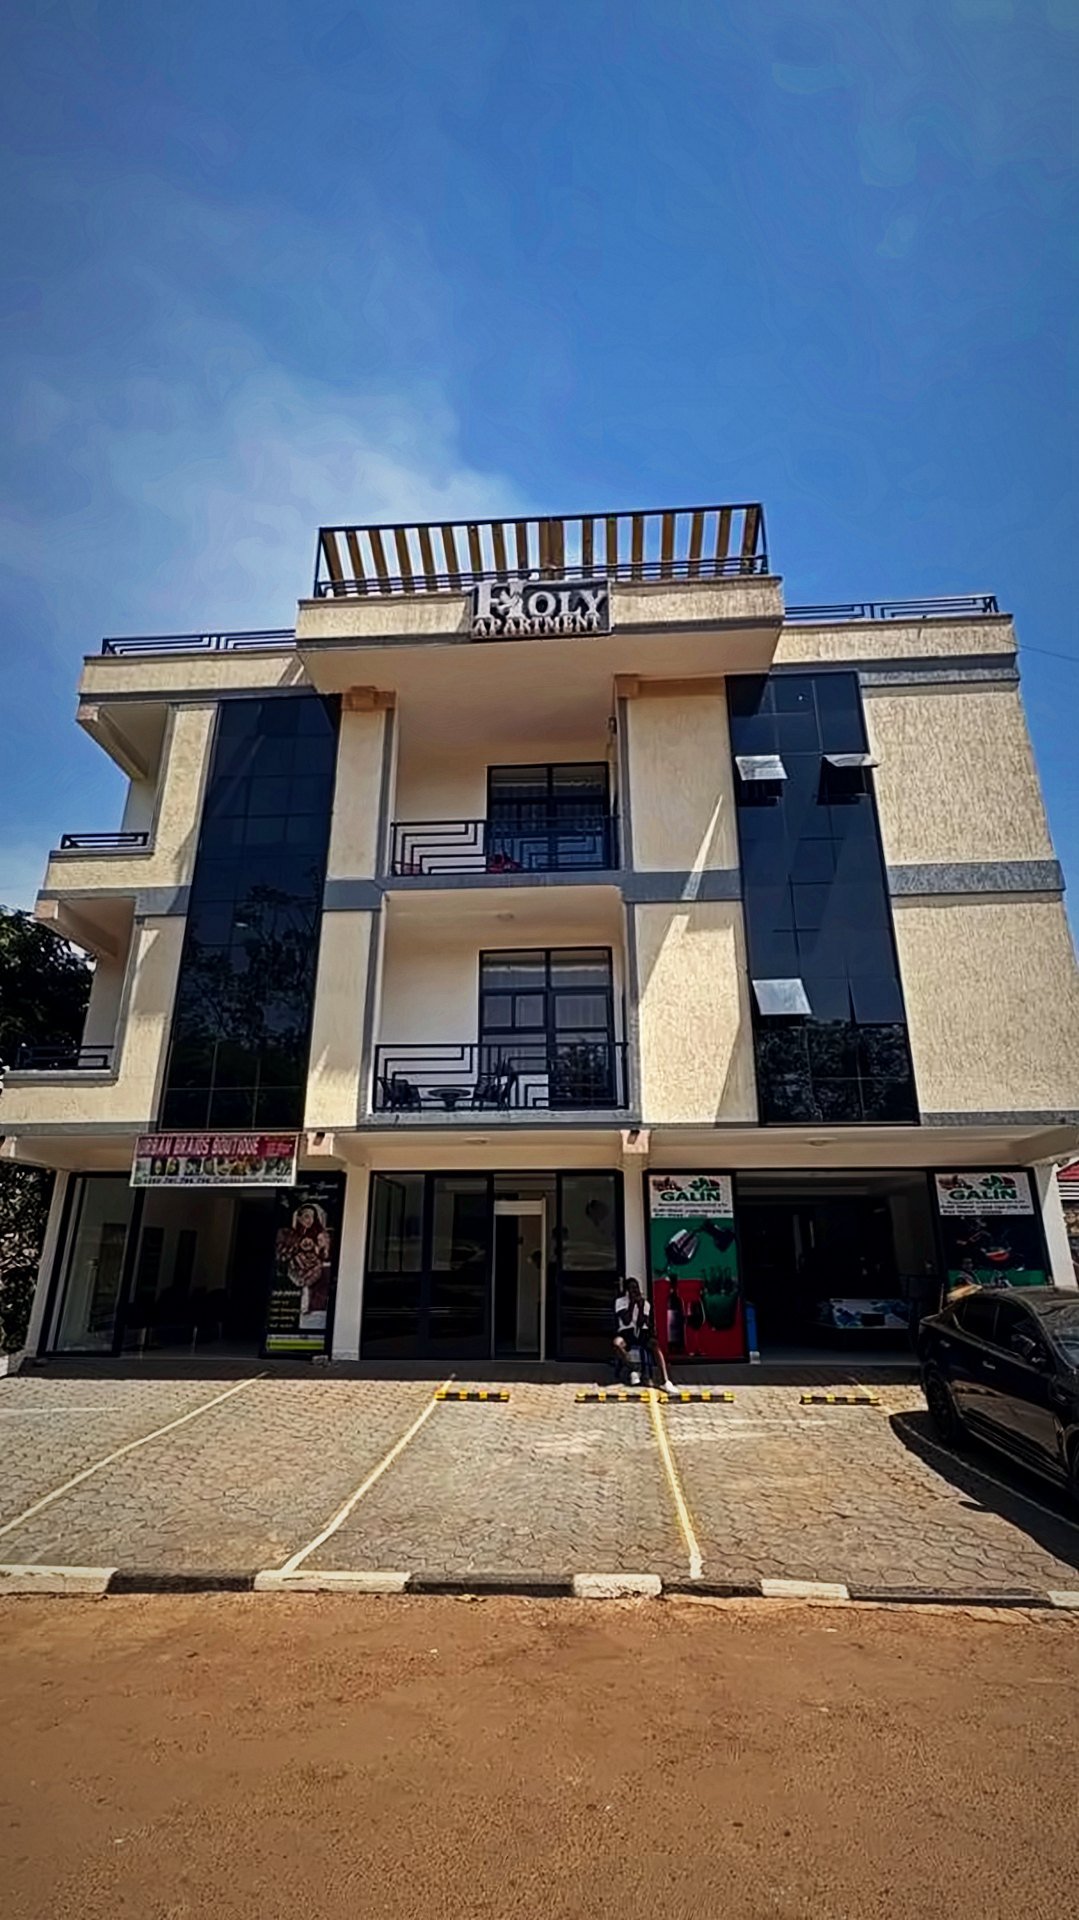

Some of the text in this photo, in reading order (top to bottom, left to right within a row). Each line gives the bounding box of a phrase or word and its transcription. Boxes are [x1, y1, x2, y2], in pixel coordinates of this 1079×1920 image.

[474, 581, 607, 617] HOLY
[474, 615, 600, 635] APARTMENT
[210, 1136, 260, 1154] BOUTIQUE
